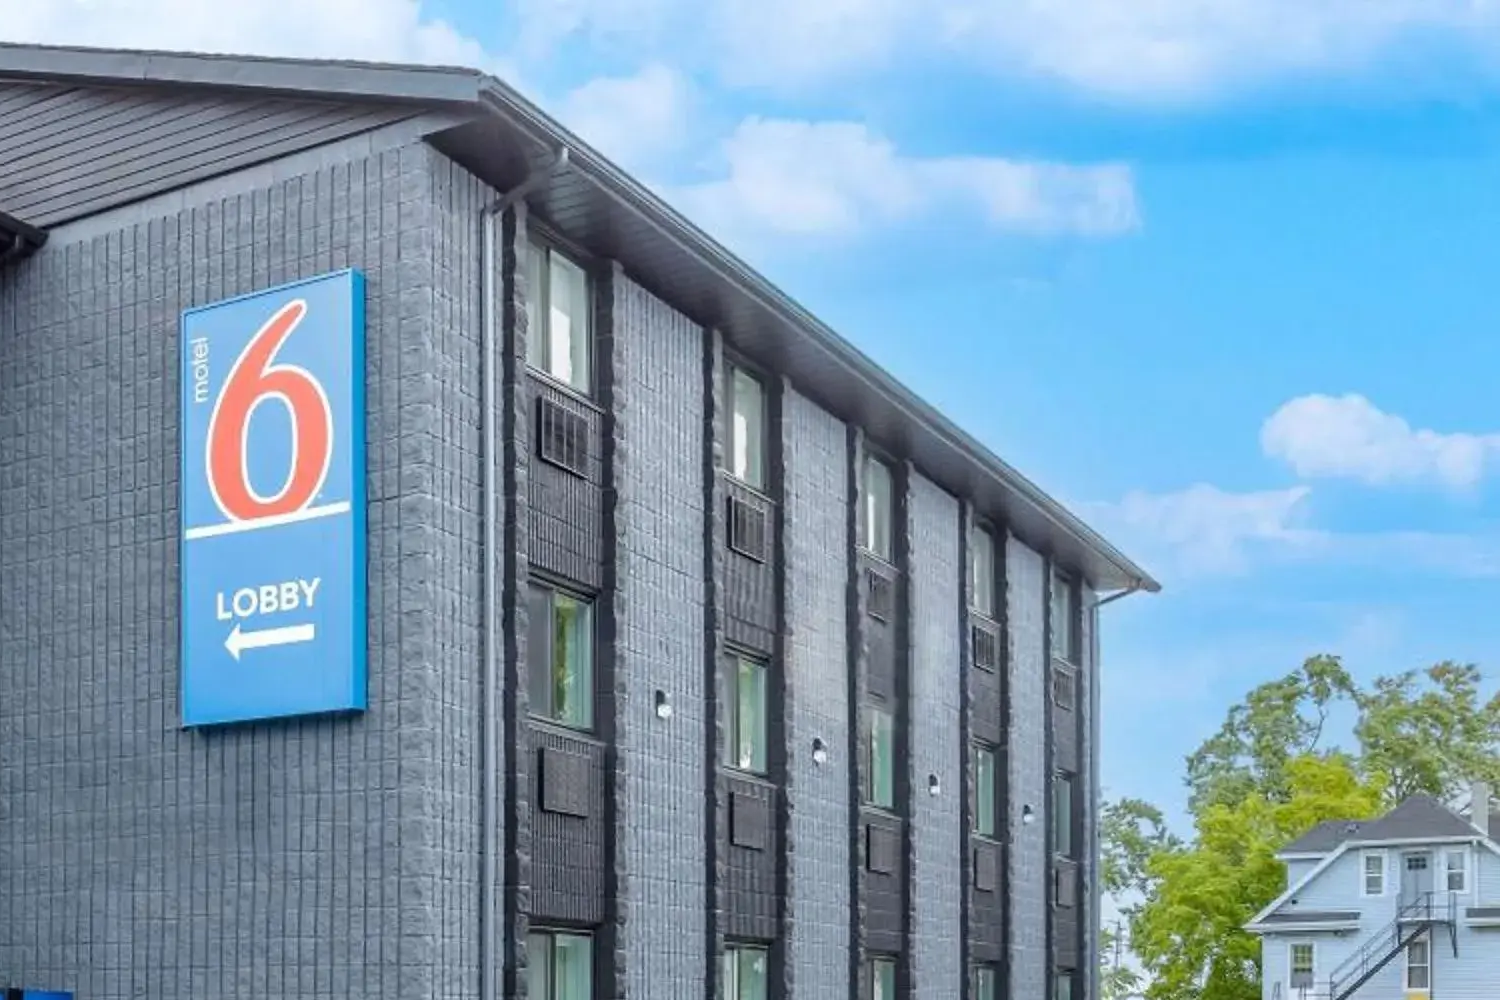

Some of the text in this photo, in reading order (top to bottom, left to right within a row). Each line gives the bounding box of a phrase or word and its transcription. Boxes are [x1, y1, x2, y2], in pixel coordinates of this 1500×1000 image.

[191, 337, 209, 402] motel
[205, 299, 333, 524] 6
[216, 577, 322, 621] LOBBY
